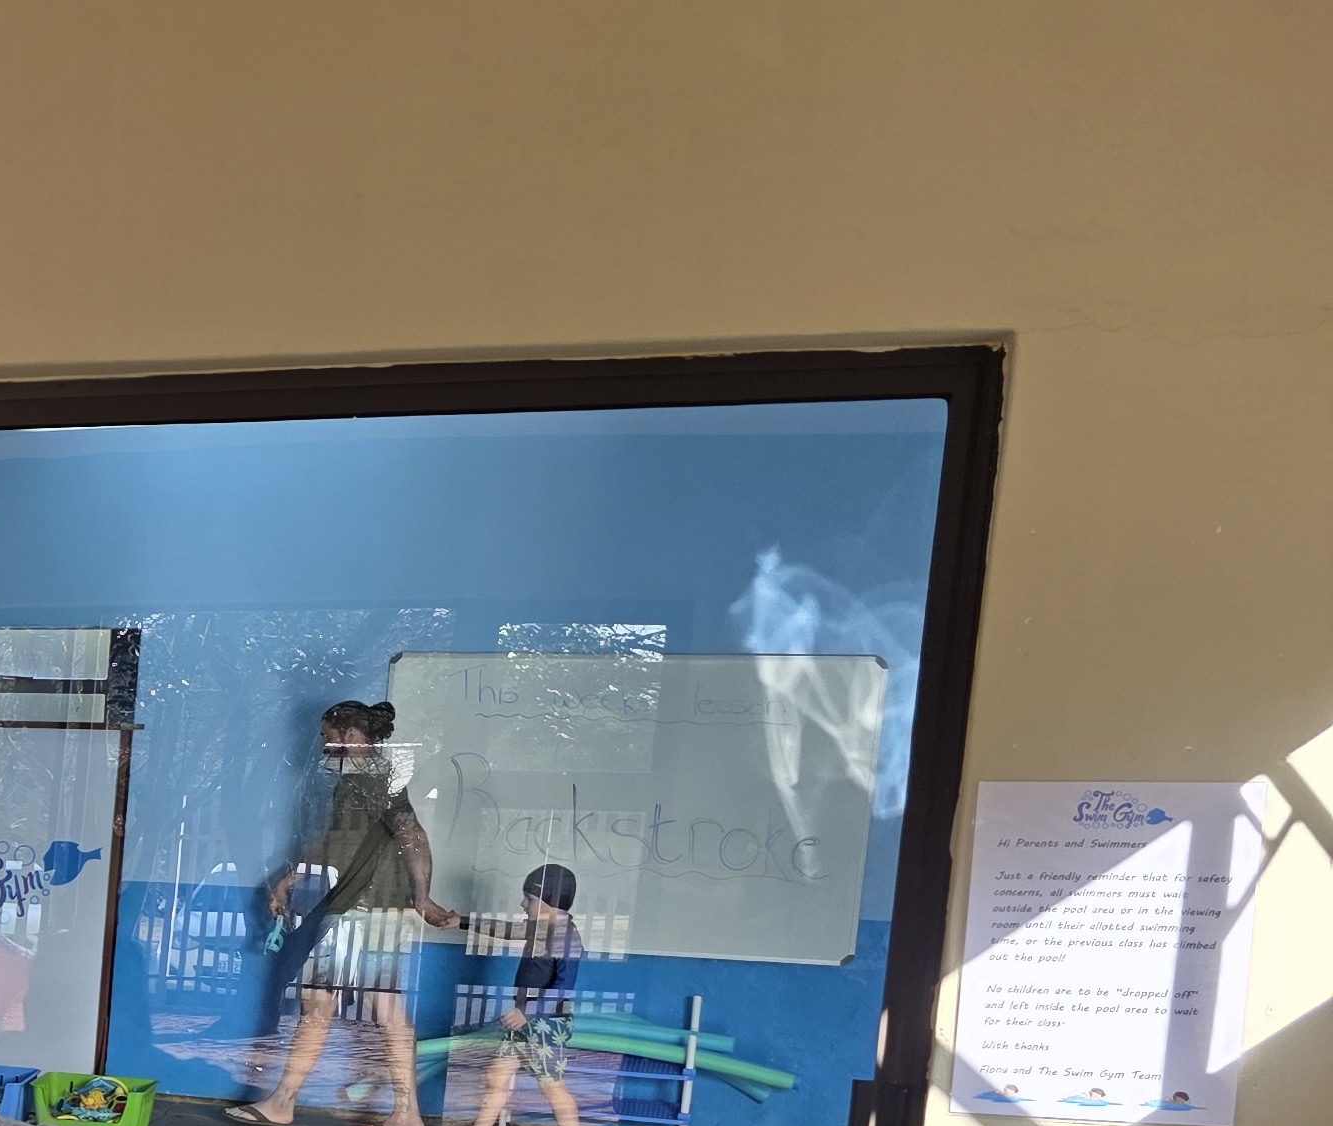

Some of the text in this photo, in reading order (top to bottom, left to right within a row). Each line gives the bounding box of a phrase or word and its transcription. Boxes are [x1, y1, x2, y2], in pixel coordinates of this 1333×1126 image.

[449, 664, 520, 706] This
[693, 682, 788, 716] lesson
[1093, 790, 1115, 812] The
[1073, 801, 1144, 829] Swim Gym
[997, 838, 1148, 849] Hi Parents and Swimmers
[994, 870, 1022, 880] Just
[1039, 871, 1082, 883] friendly
[1086, 872, 1137, 882] reminder
[1142, 873, 1169, 882] that
[1174, 873, 1193, 883] for
[1197, 873, 1234, 885] safety
[993, 889, 1043, 897] concerns,
[1049, 888, 1064, 897] all
[1067, 888, 1123, 898] swimmers
[1127, 890, 1156, 898] must
[992, 903, 1032, 913] outside
[1038, 904, 1058, 913] the
[1062, 904, 1088, 915] pool
[1137, 906, 1149, 915] in
[1154, 906, 1174, 915] the
[1181, 907, 1221, 919] viewing
[991, 920, 1195, 935] room until their allotted swimming
[990, 937, 1019, 946] time,
[1044, 936, 1063, 946] the
[1067, 938, 1114, 948] previous
[1118, 939, 1144, 948] class
[1149, 939, 1168, 948] has
[1173, 939, 1217, 950] climbed
[989, 952, 1067, 963] out the pool!
[985, 984, 1003, 993] No
[1007, 984, 1050, 995] children
[1078, 987, 1091, 996] to
[1096, 987, 1109, 997] be
[984, 1000, 1005, 1009] and
[1009, 1000, 1029, 1010] left
[1035, 1002, 1065, 1011] inside
[1071, 1003, 1090, 1012] the
[1095, 1004, 1120, 1014] pool
[1154, 1006, 1168, 1015] to
[1174, 1007, 1200, 1016] wait
[984, 1016, 1001, 1025] for
[1006, 1017, 1034, 1026] their
[981, 1040, 1050, 1051] With thanks
[979, 1064, 1162, 1081] Fiona and The Swim Gym Team
